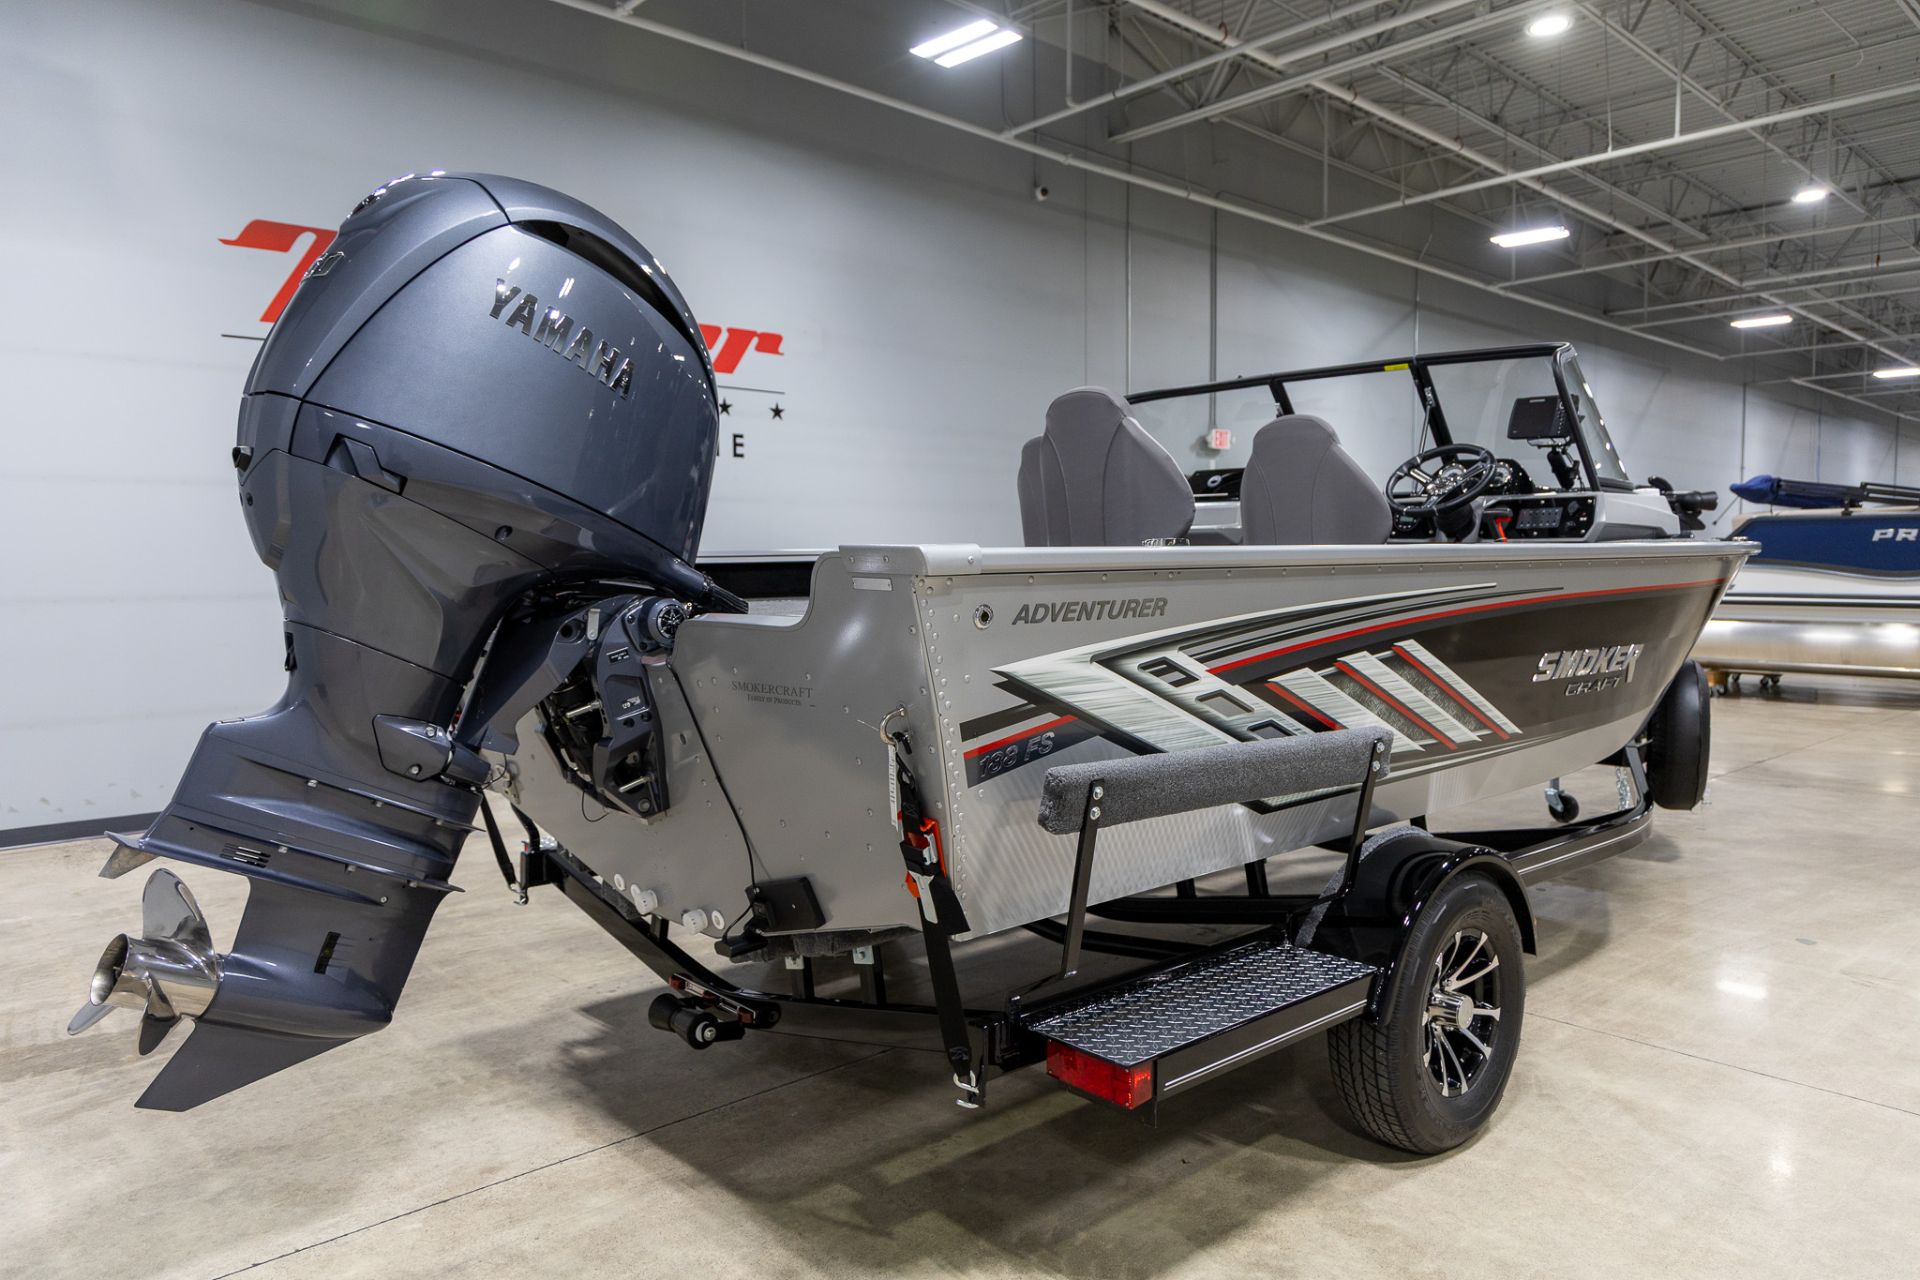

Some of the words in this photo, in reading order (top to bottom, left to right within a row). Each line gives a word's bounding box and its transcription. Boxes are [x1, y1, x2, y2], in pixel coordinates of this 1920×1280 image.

[489, 278, 635, 400] YAMAHA
[1012, 597, 1168, 625] ADVENTURER
[1532, 643, 1645, 683] SMOKER
[732, 681, 813, 699] SMOKERCRAFT
[1565, 677, 1623, 696] CRAFT
[979, 744, 1018, 778] 188
[1024, 731, 1055, 761] FS
